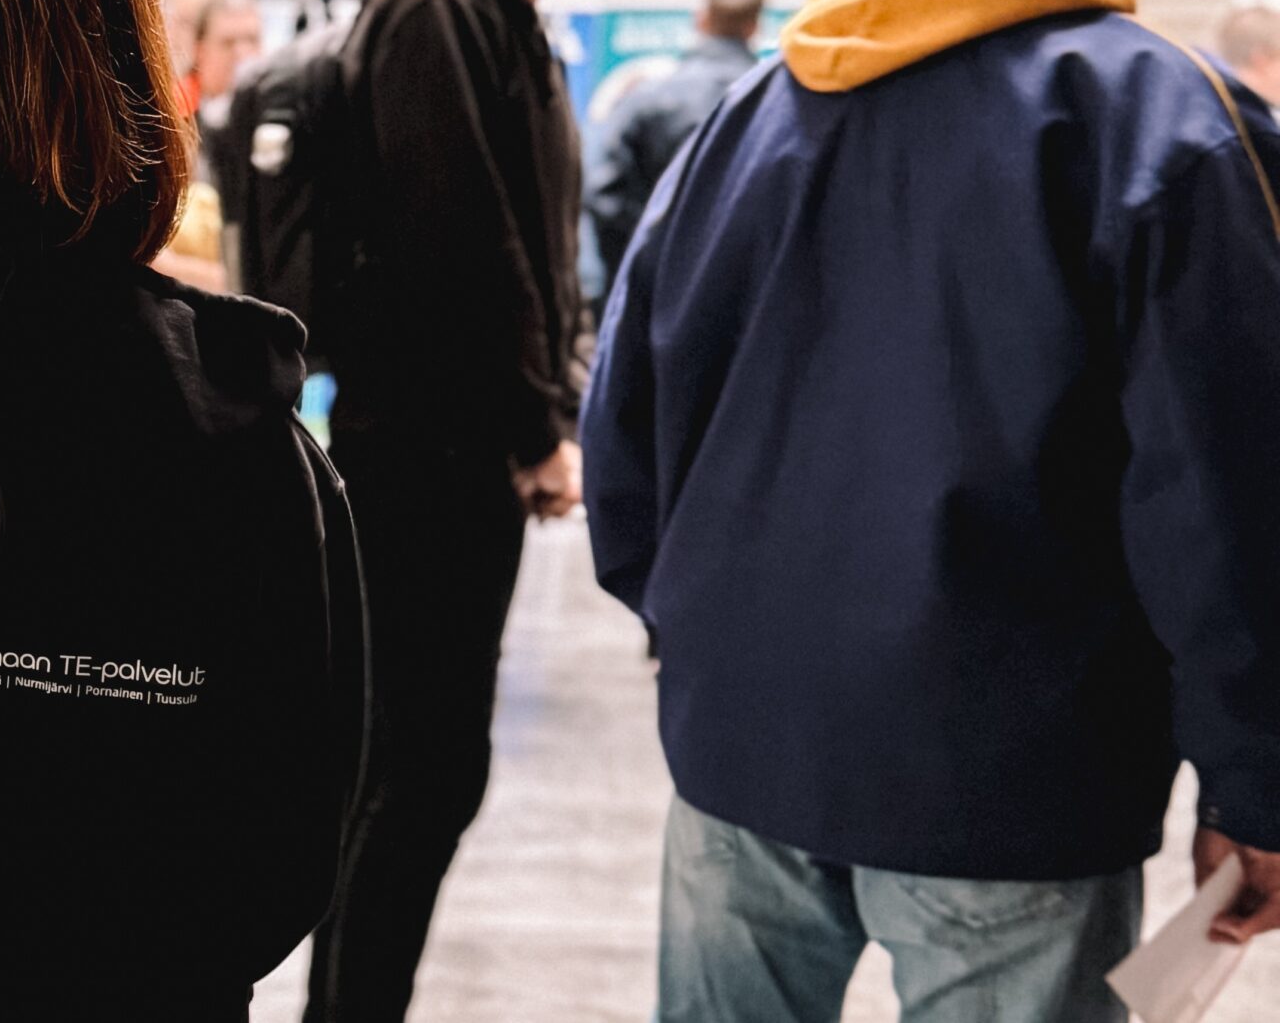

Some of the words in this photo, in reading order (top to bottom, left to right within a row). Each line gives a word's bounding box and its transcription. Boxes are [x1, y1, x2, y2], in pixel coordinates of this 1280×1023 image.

[59, 654, 207, 687] TE-palvelut
[14, 675, 73, 695] Nurmijärvi
[85, 685, 144, 702] Pornainen
